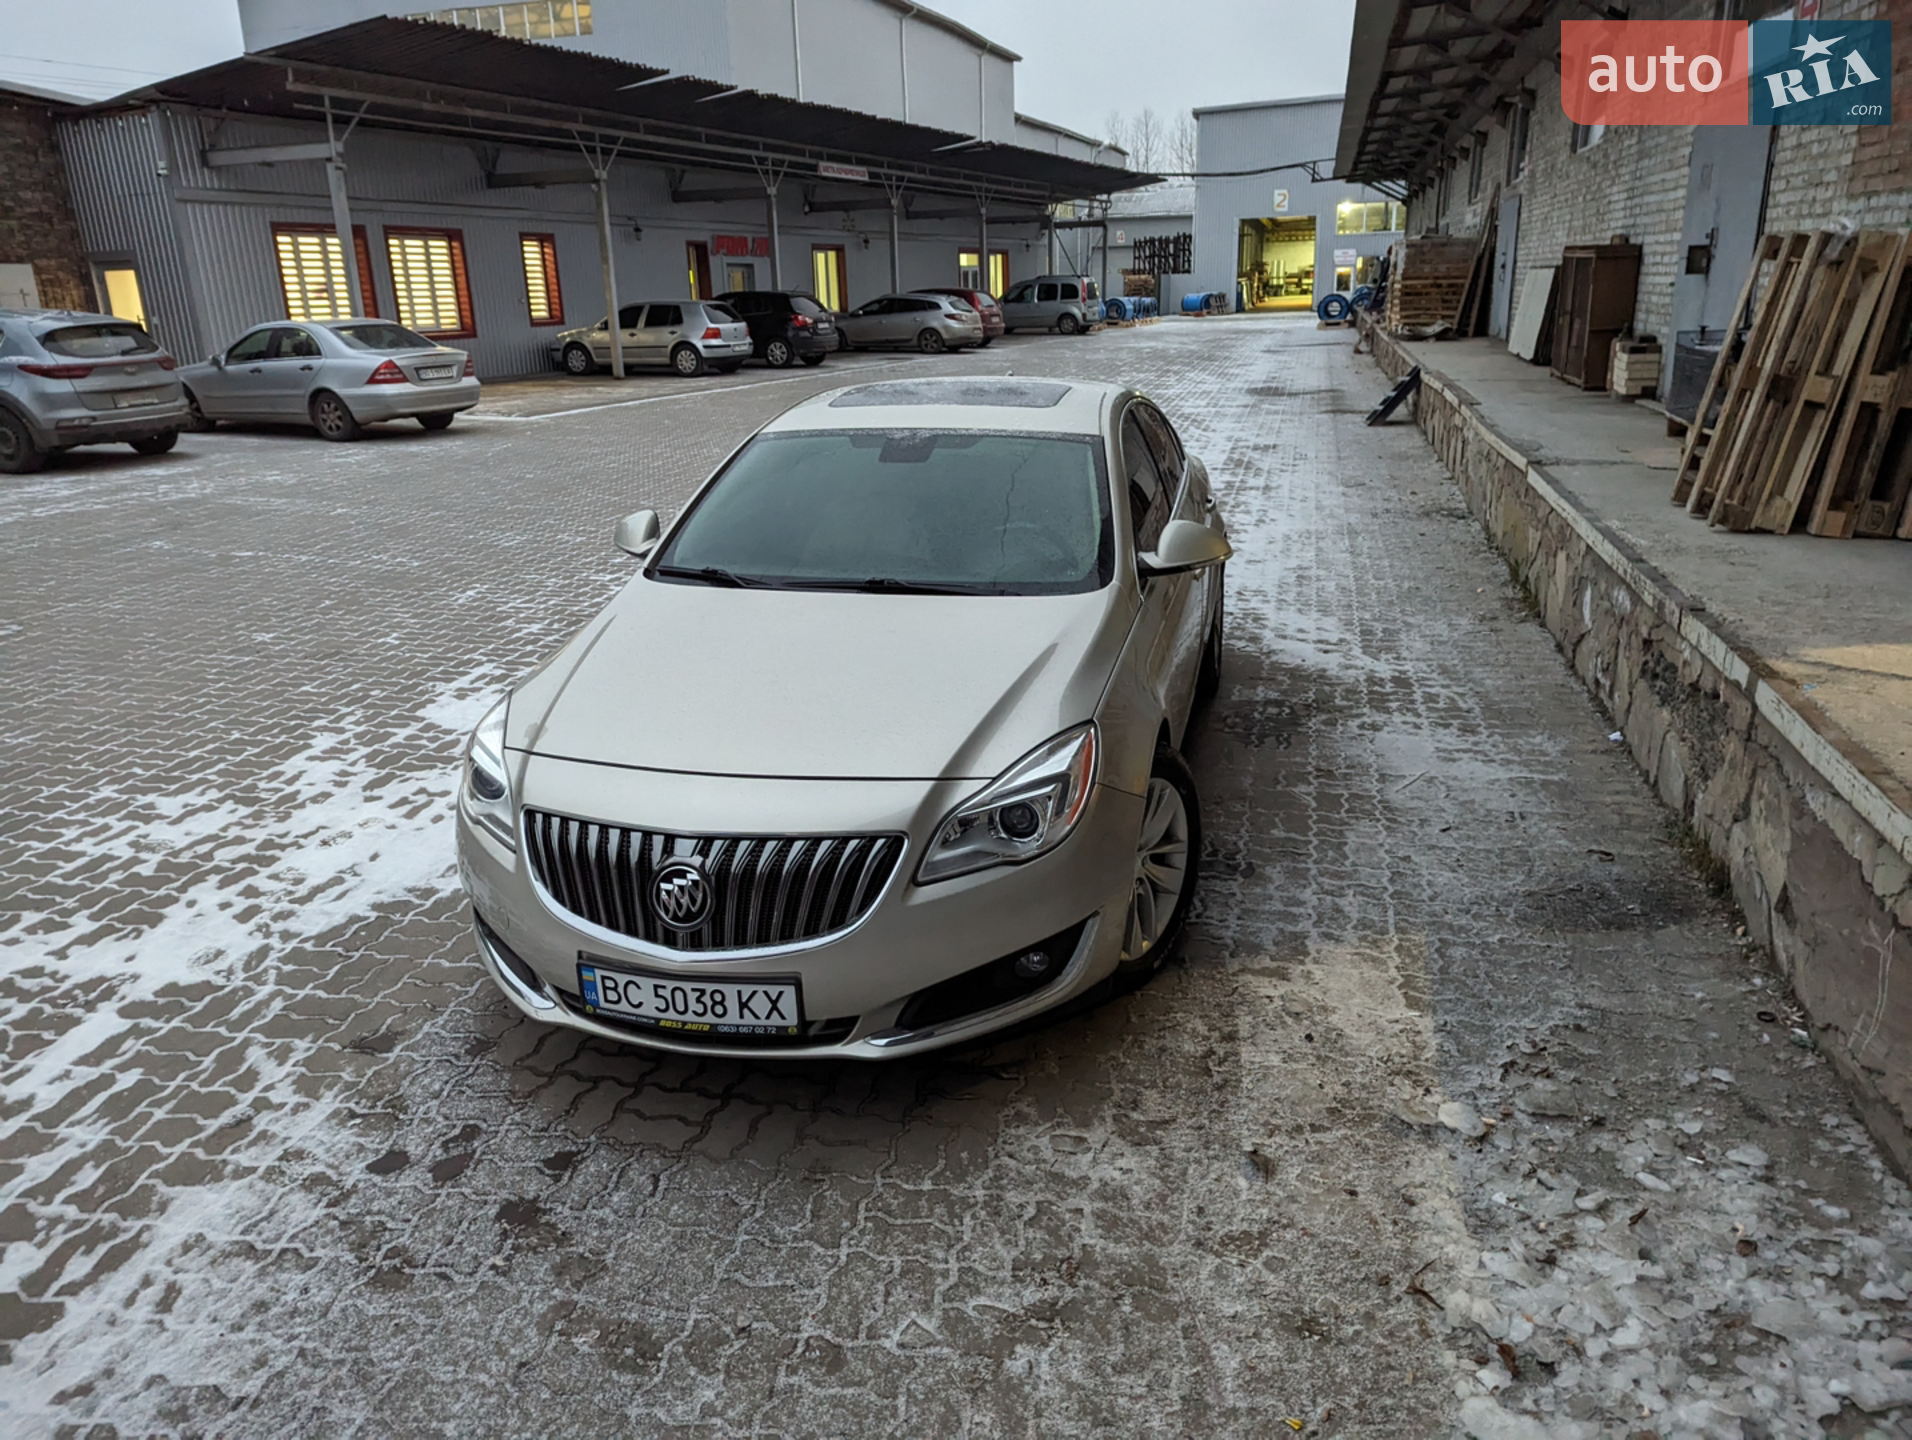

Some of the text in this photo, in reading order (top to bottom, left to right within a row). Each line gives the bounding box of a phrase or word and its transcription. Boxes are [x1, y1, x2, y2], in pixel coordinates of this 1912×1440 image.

[1276, 192, 1287, 208] 2
[584, 990, 598, 1001] UA
[600, 974, 787, 1021] BC 5038 KX
[659, 1019, 711, 1032] BOSS AUTO
[717, 1024, 738, 1033] (063)
[754, 1026, 765, 1034] 02
[766, 1026, 777, 1034] 72
